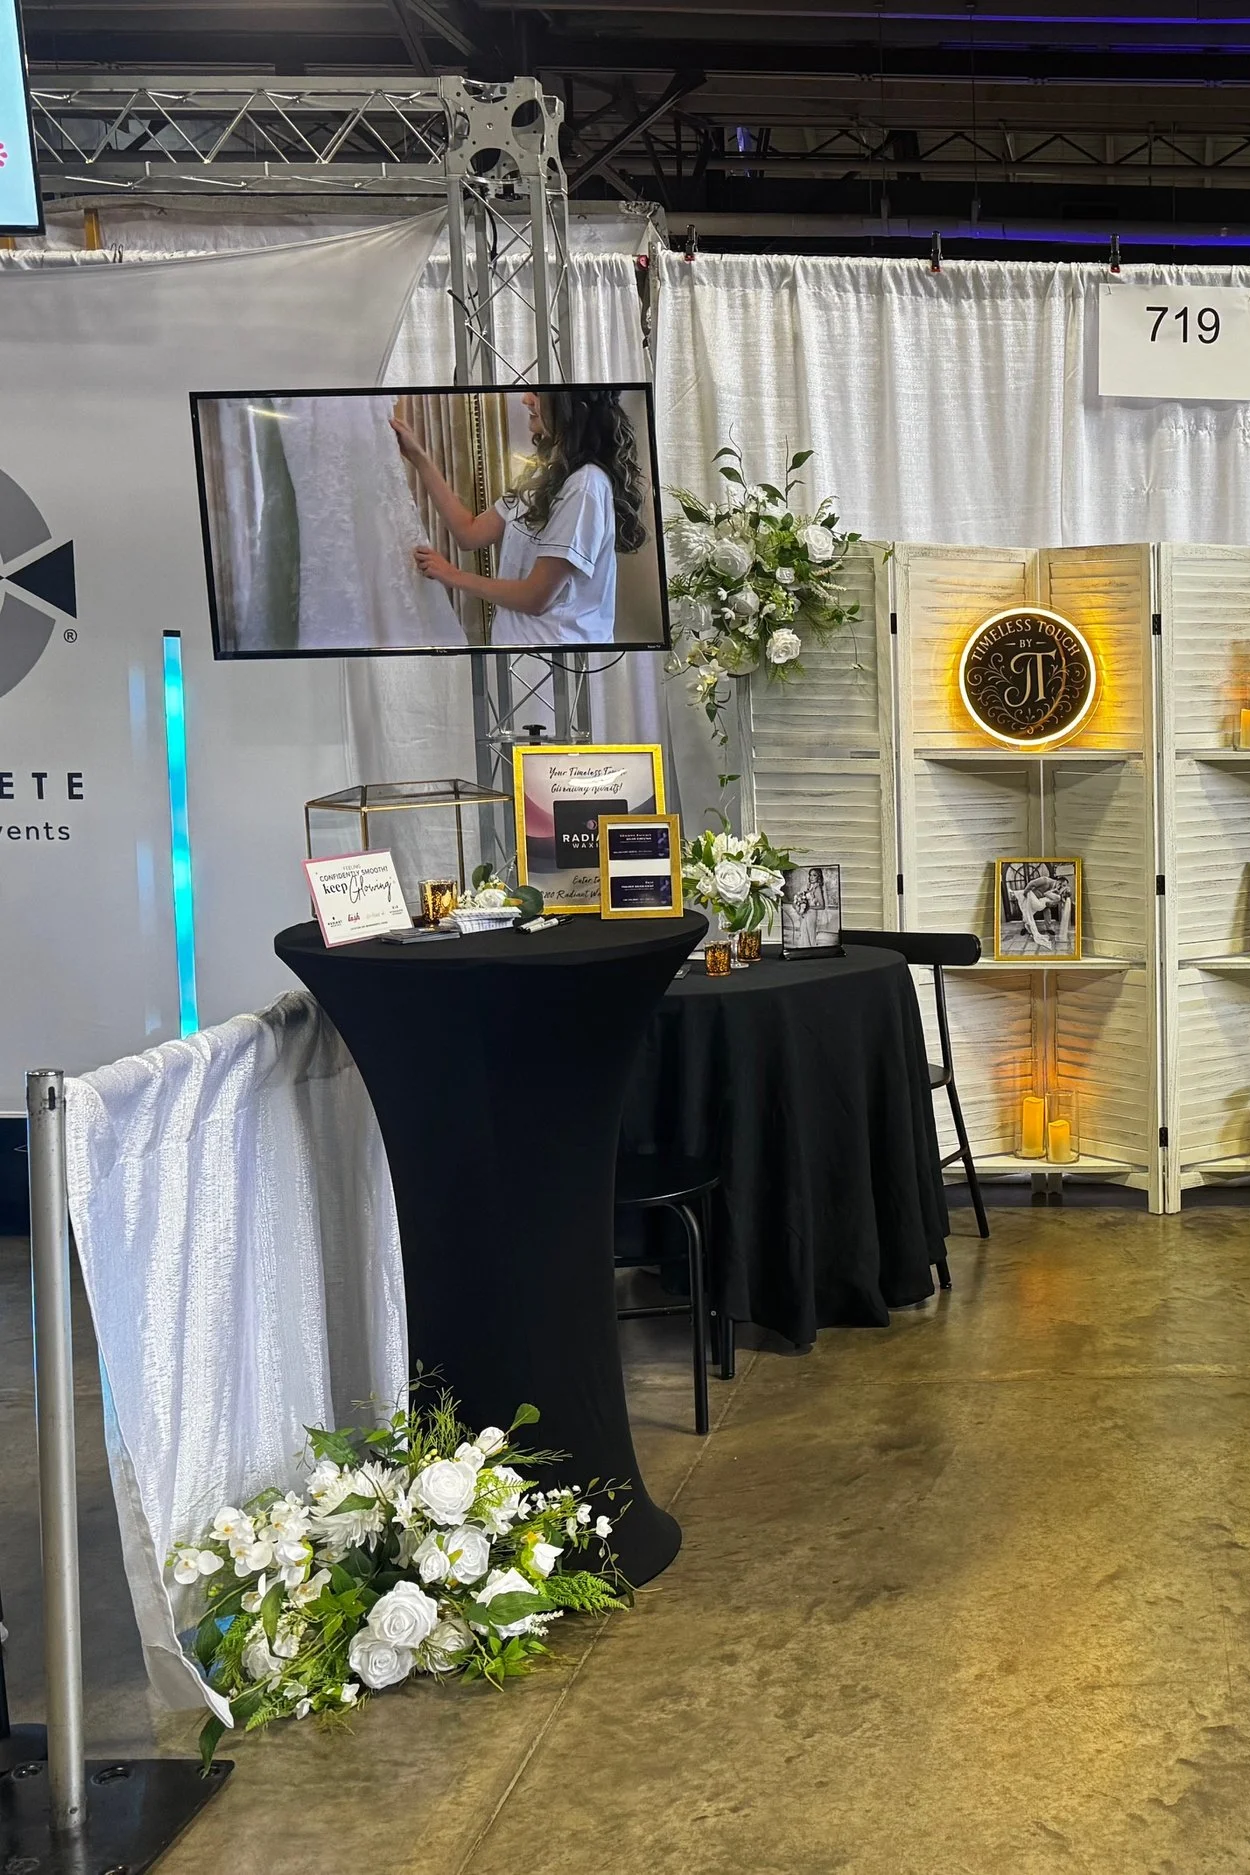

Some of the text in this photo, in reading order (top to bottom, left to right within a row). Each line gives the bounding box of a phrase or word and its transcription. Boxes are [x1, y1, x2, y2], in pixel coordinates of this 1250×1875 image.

[1145, 306, 1220, 344] 719
[970, 618, 1081, 662] TIMELESS TOUCH
[1019, 638, 1033, 648] BY
[549, 767, 567, 779] Your
[569, 766, 601, 778] Timeless
[0, 822, 71, 841] ents
[319, 869, 360, 882] CONFIDENTLY
[572, 875, 592, 885] Enter
[322, 875, 392, 904] keep Glowing
[556, 889, 589, 899] Radiant
